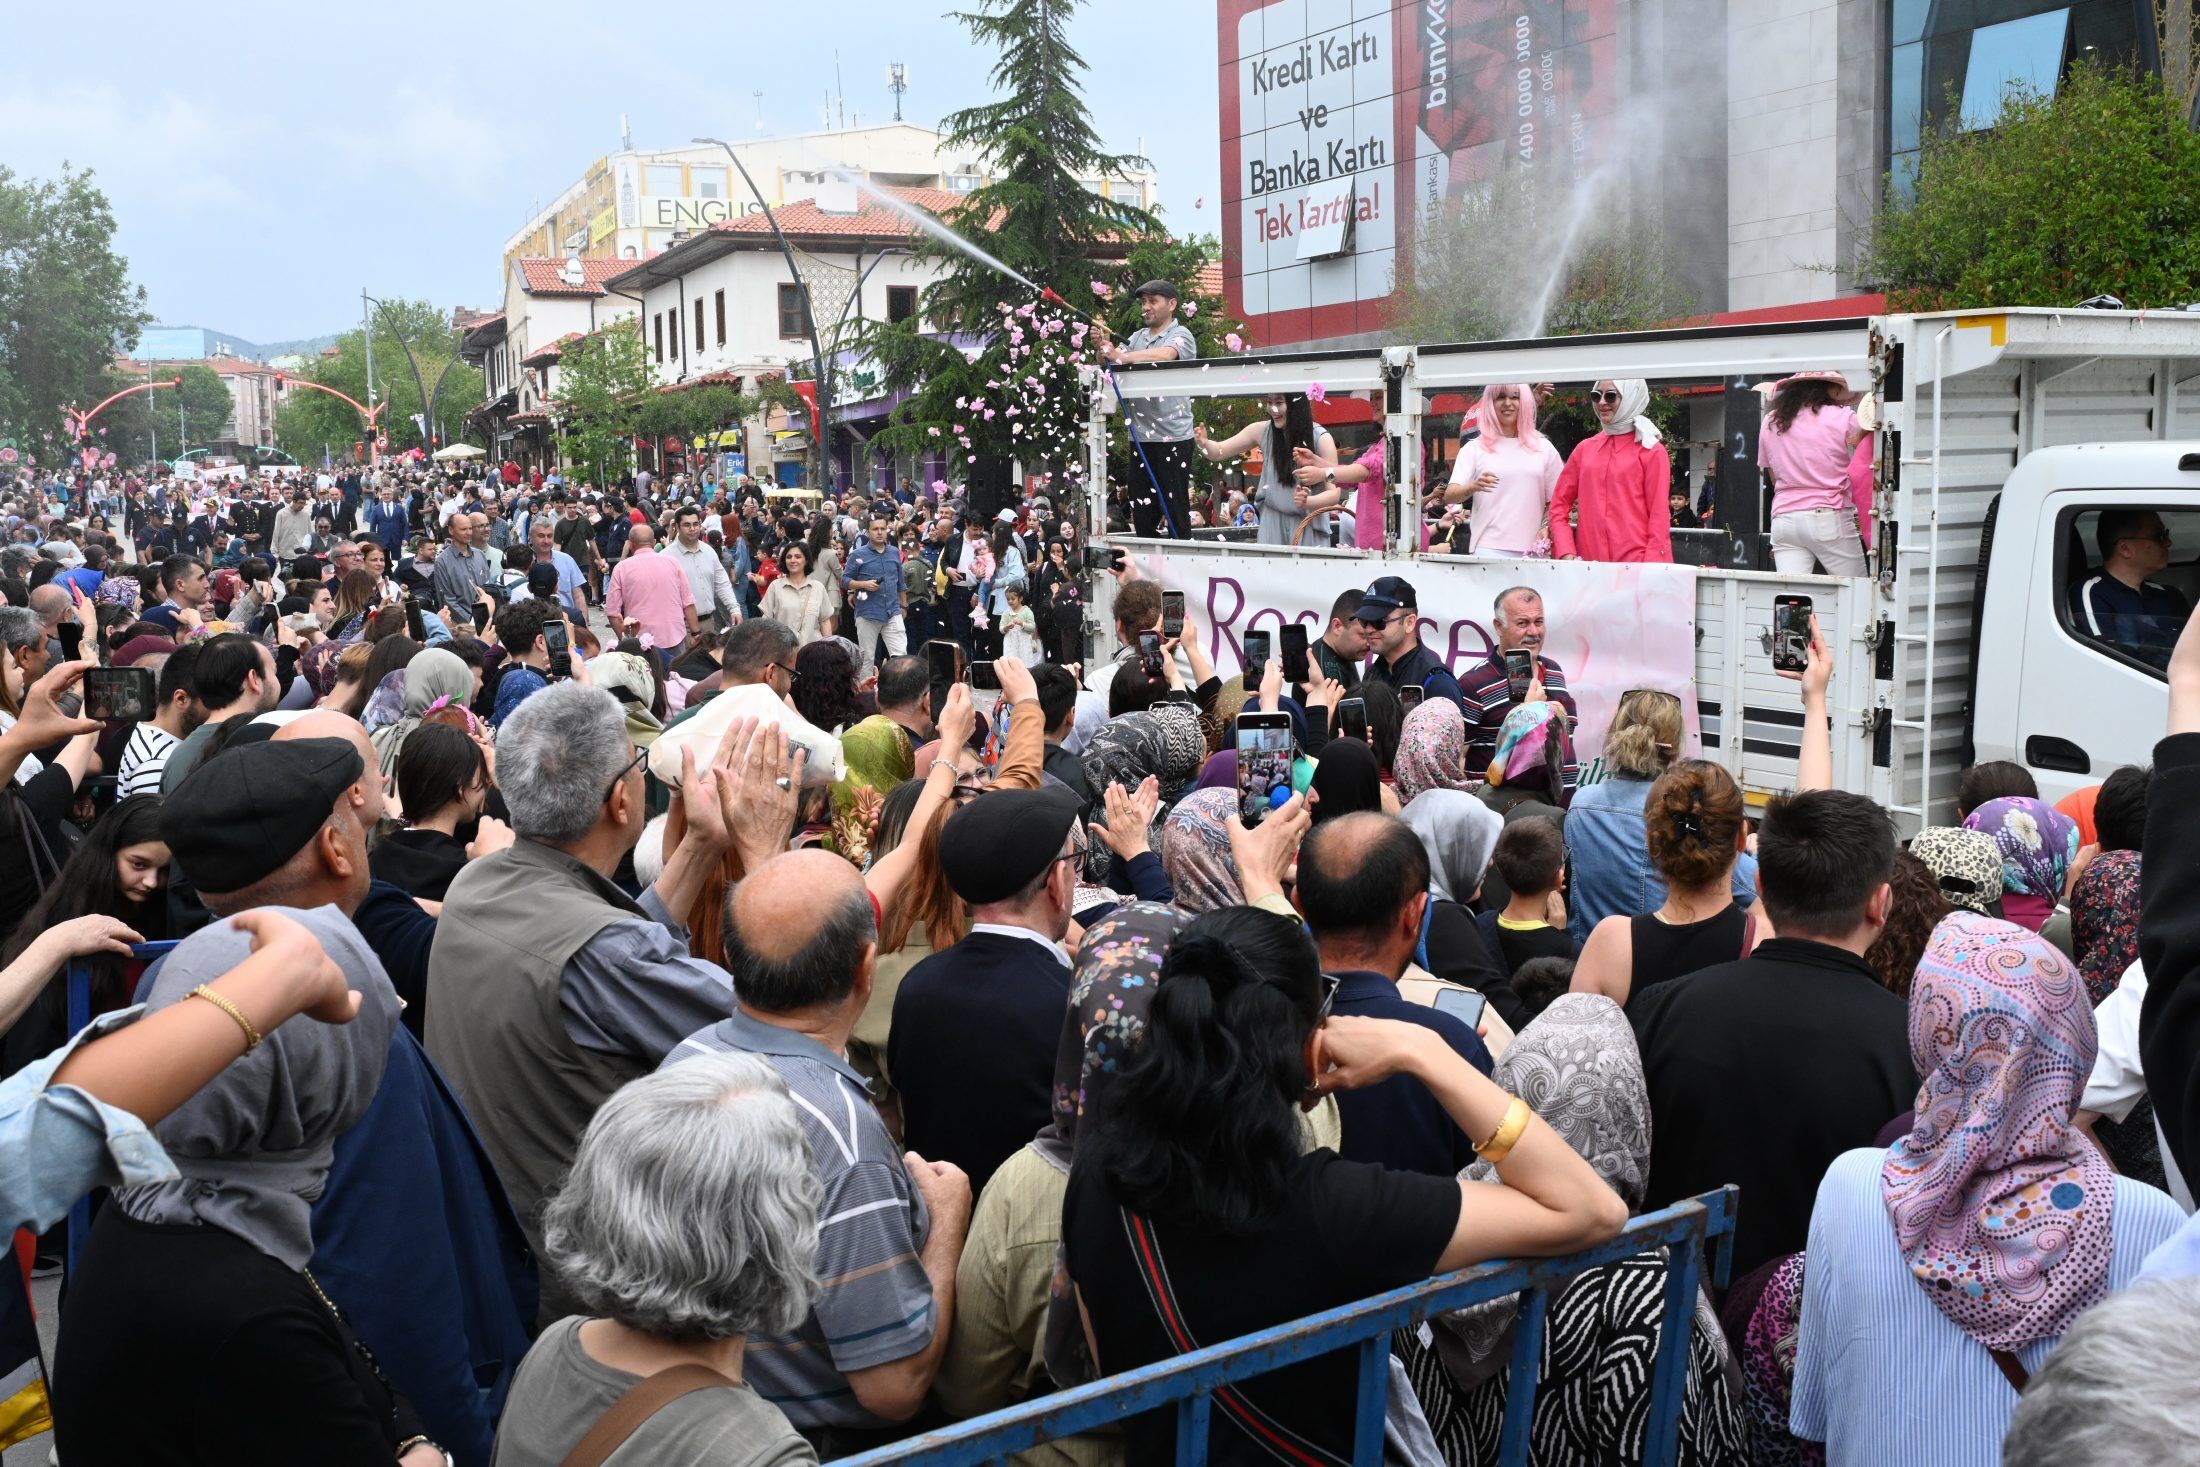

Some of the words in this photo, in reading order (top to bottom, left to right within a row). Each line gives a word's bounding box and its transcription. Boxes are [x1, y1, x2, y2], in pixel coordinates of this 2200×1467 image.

[1515, 15, 1531, 62] 0000
[1251, 44, 1313, 96] Kredi
[1319, 32, 1378, 75] Kartı
[1517, 68, 1533, 116] 0000
[1298, 104, 1328, 132] ve
[1249, 149, 1321, 195] Banka
[1327, 136, 1386, 177] Kartı
[1426, 155, 1439, 213] Bankası
[1254, 202, 1293, 243] Tek
[727, 458, 745, 467] Erikl
[1734, 432, 1748, 460] 2
[1733, 540, 1747, 565] 2
